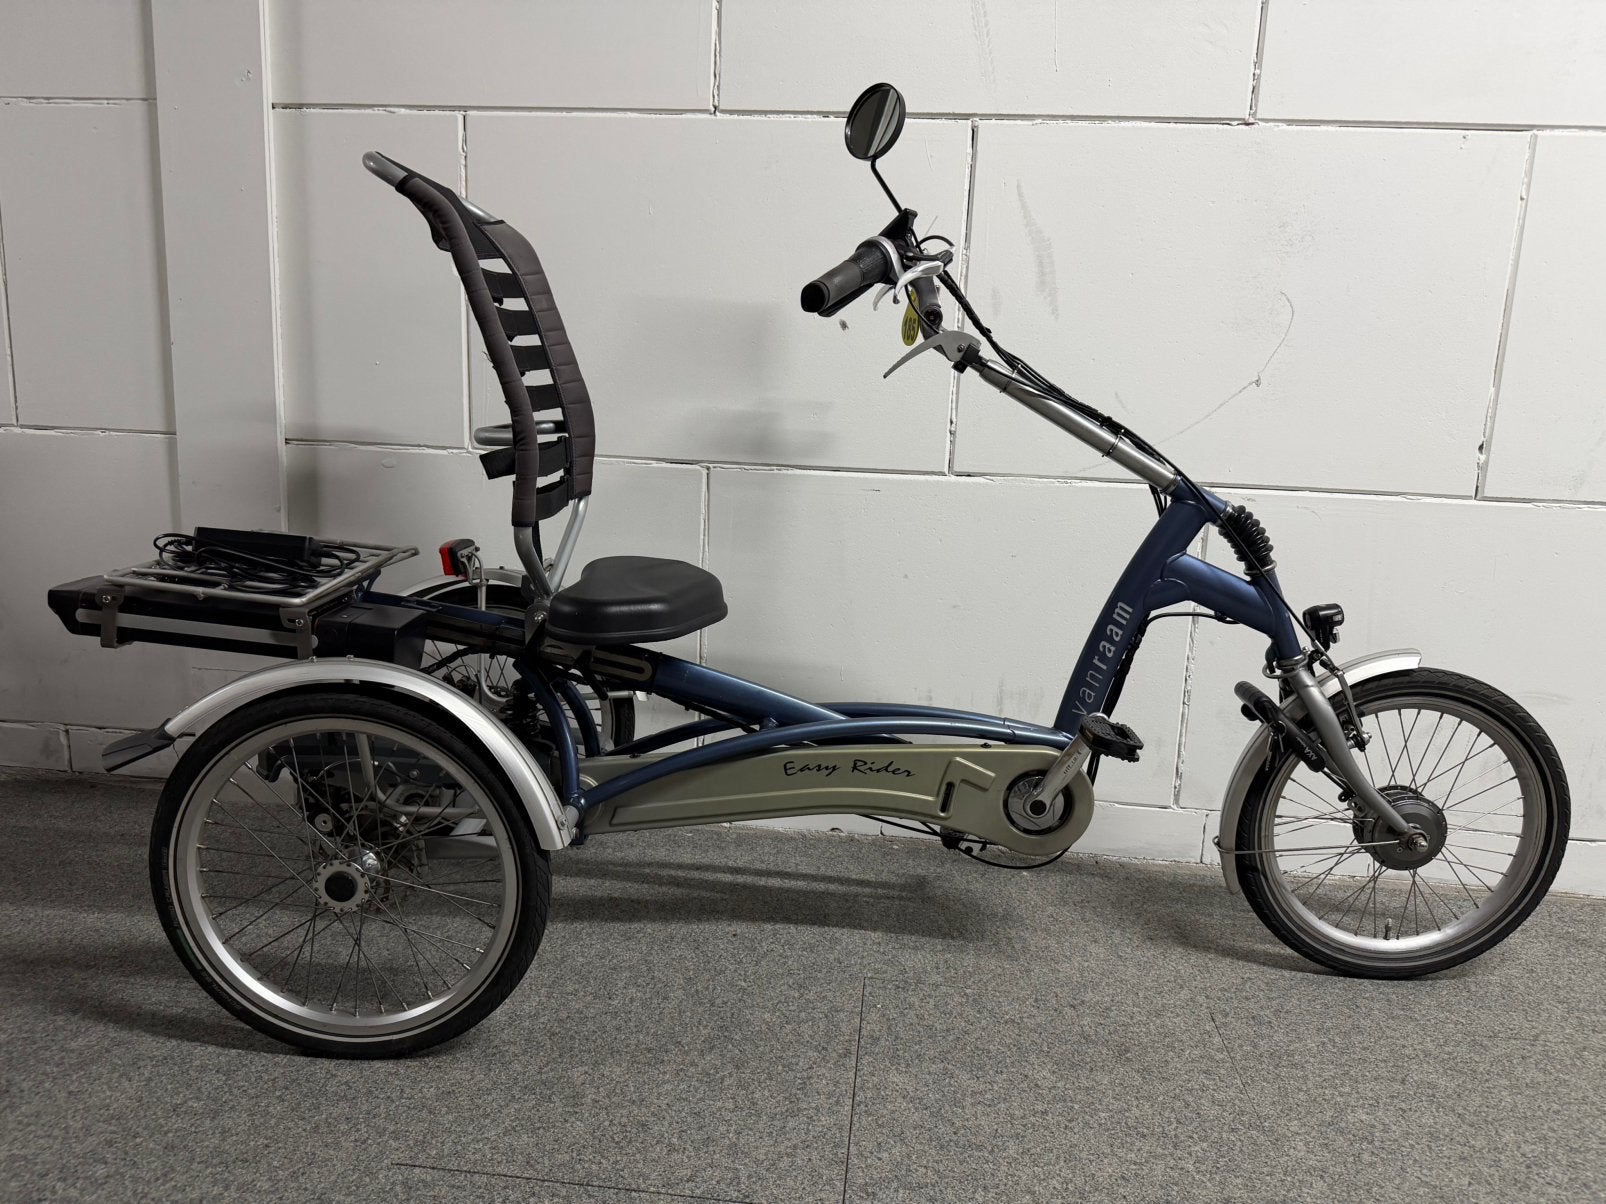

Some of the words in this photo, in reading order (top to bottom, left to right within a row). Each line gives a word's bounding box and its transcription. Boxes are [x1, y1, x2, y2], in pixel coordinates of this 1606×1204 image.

[1304, 747, 1318, 761] AXA
[783, 760, 841, 777] Easy
[851, 759, 916, 778] Rider
